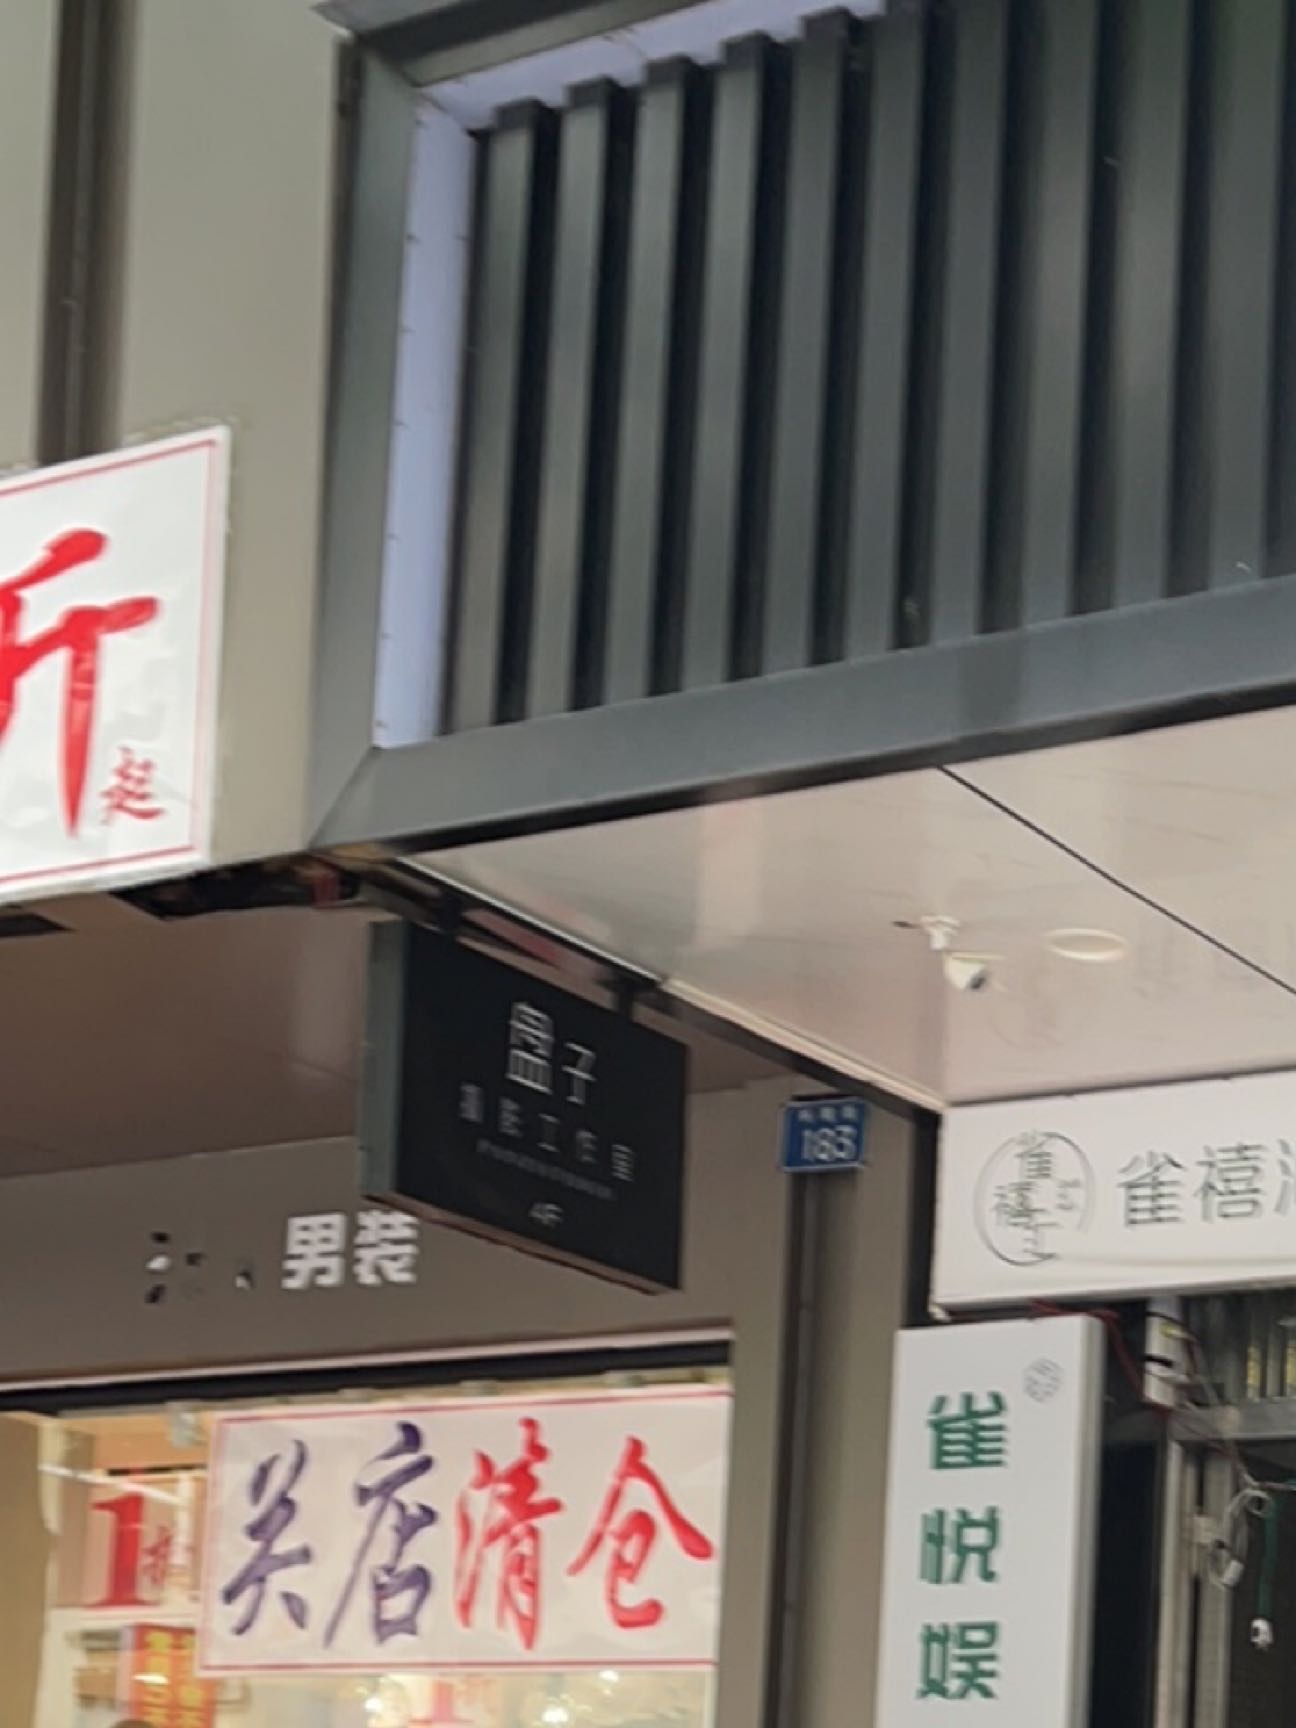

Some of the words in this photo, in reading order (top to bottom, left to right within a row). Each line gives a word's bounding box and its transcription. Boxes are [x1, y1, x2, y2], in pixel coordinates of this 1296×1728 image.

[281, 1210, 420, 1290] 男装
[221, 1417, 714, 1652] 关店清仓
